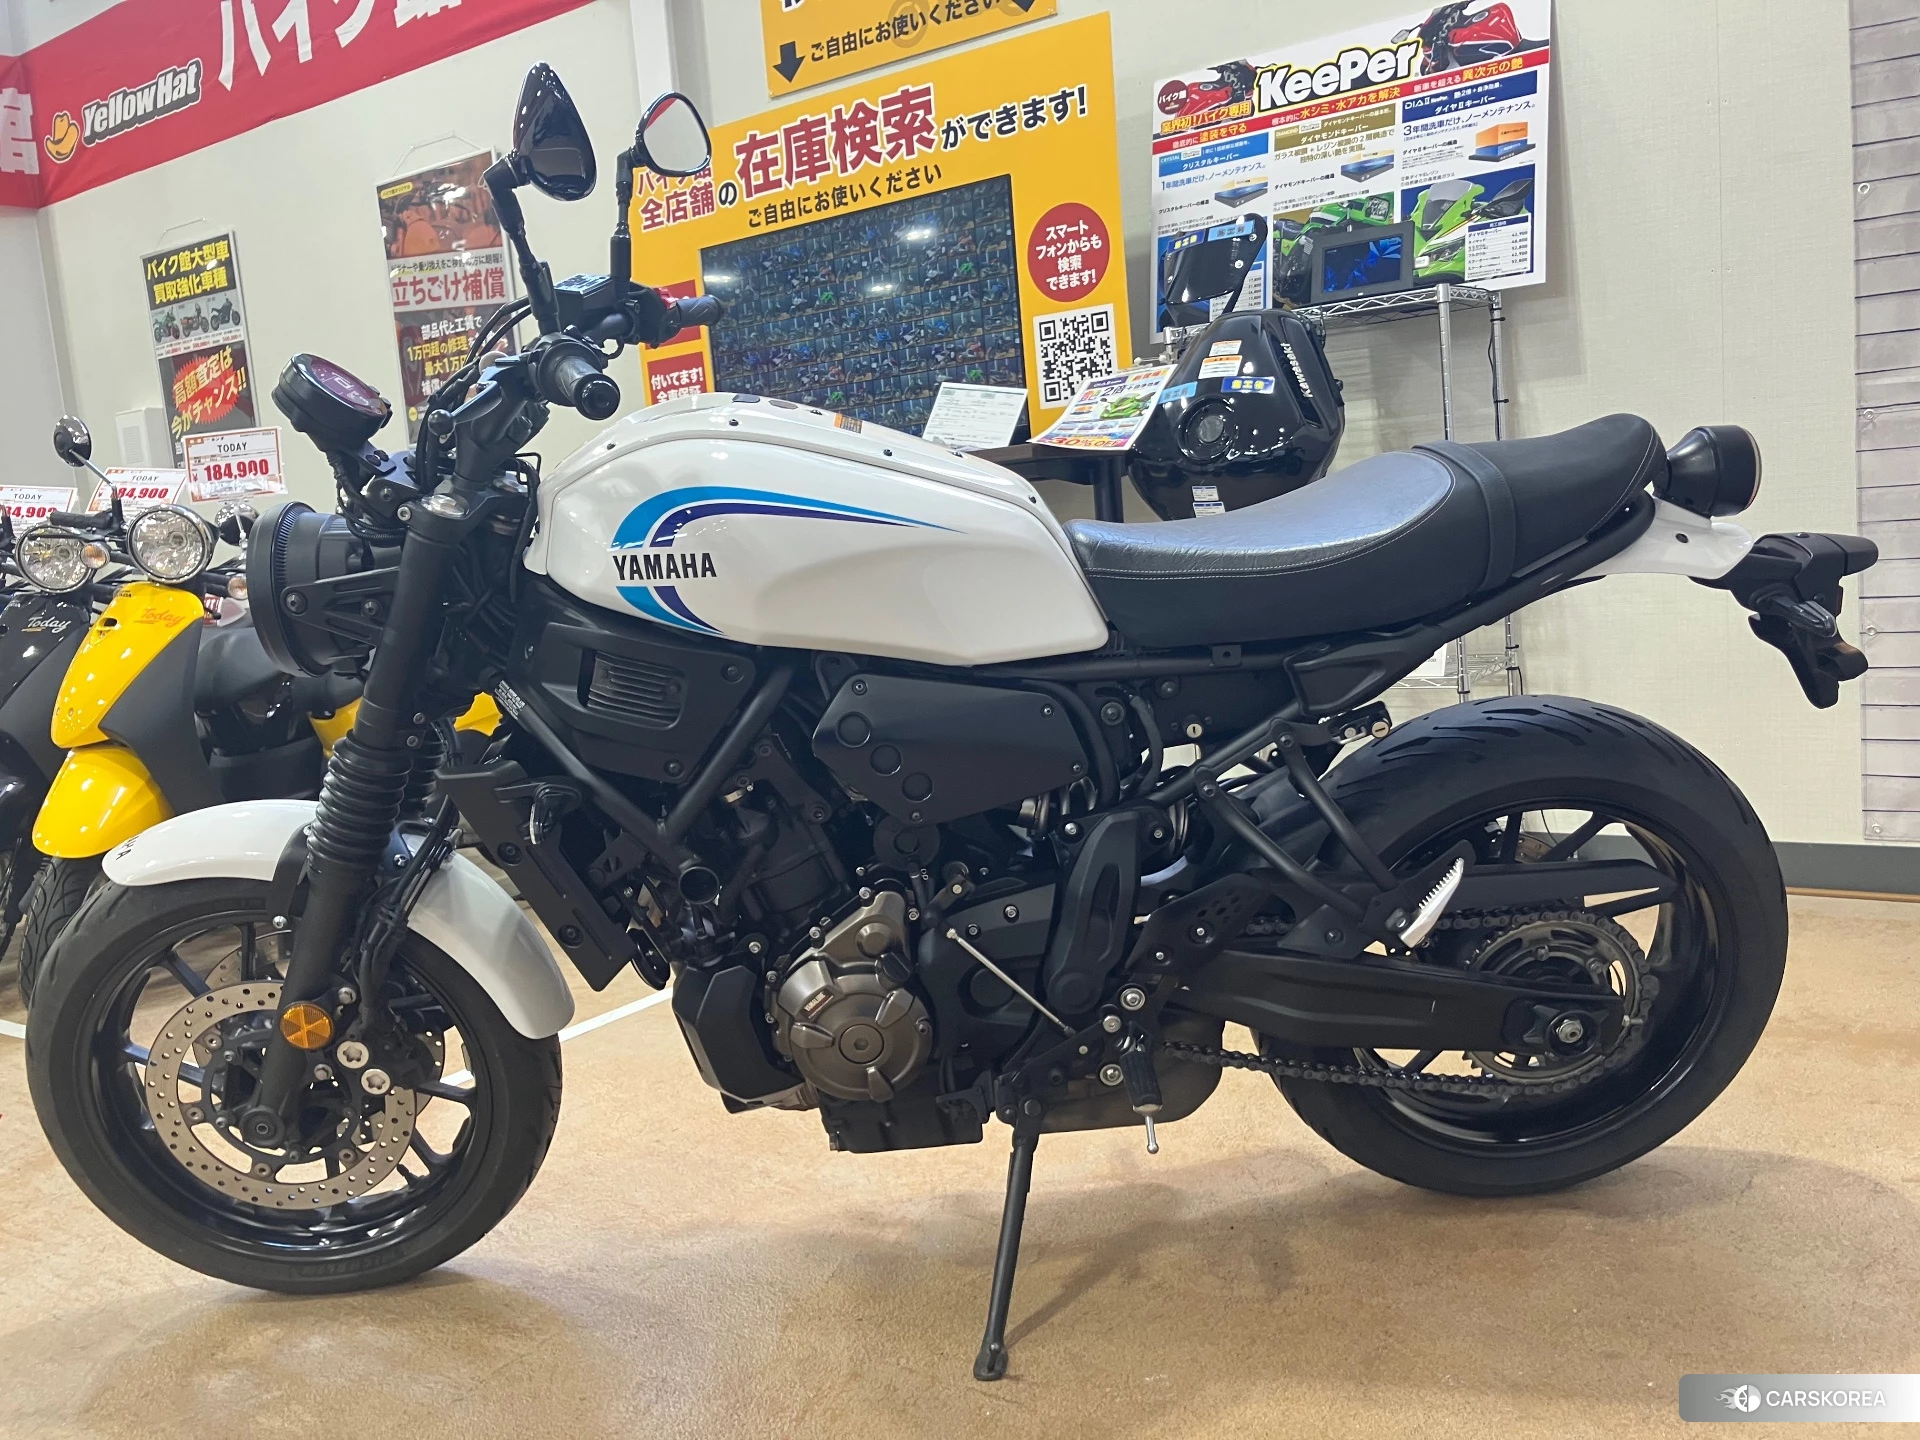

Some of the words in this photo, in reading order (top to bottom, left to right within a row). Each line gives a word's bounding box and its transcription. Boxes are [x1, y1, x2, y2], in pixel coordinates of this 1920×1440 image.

[1257, 41, 1419, 112] KeePer
[82, 61, 201, 141] YellowHat
[1301, 124, 1369, 144] ダイヤモンドキーパー
[748, 162, 942, 228] ご自由にお使いください
[1045, 219, 1089, 241] スマート
[1035, 233, 1102, 260] フォンからも
[147, 240, 229, 280] バイク館大型車
[1057, 255, 1082, 273] 検索
[153, 266, 228, 304] 買取強化車種
[392, 267, 506, 307] 立ちごけ補償
[421, 314, 482, 340] 部品代と工賃で
[173, 345, 233, 408] 高額査定は
[217, 442, 247, 453] TODAY
[204, 459, 269, 481] 184,900
[111, 487, 169, 500] 84,900
[0, 505, 58, 519] 4,90
[612, 552, 717, 581] YAMAHA
[27, 616, 71, 633] Today
[140, 608, 186, 627] Today
